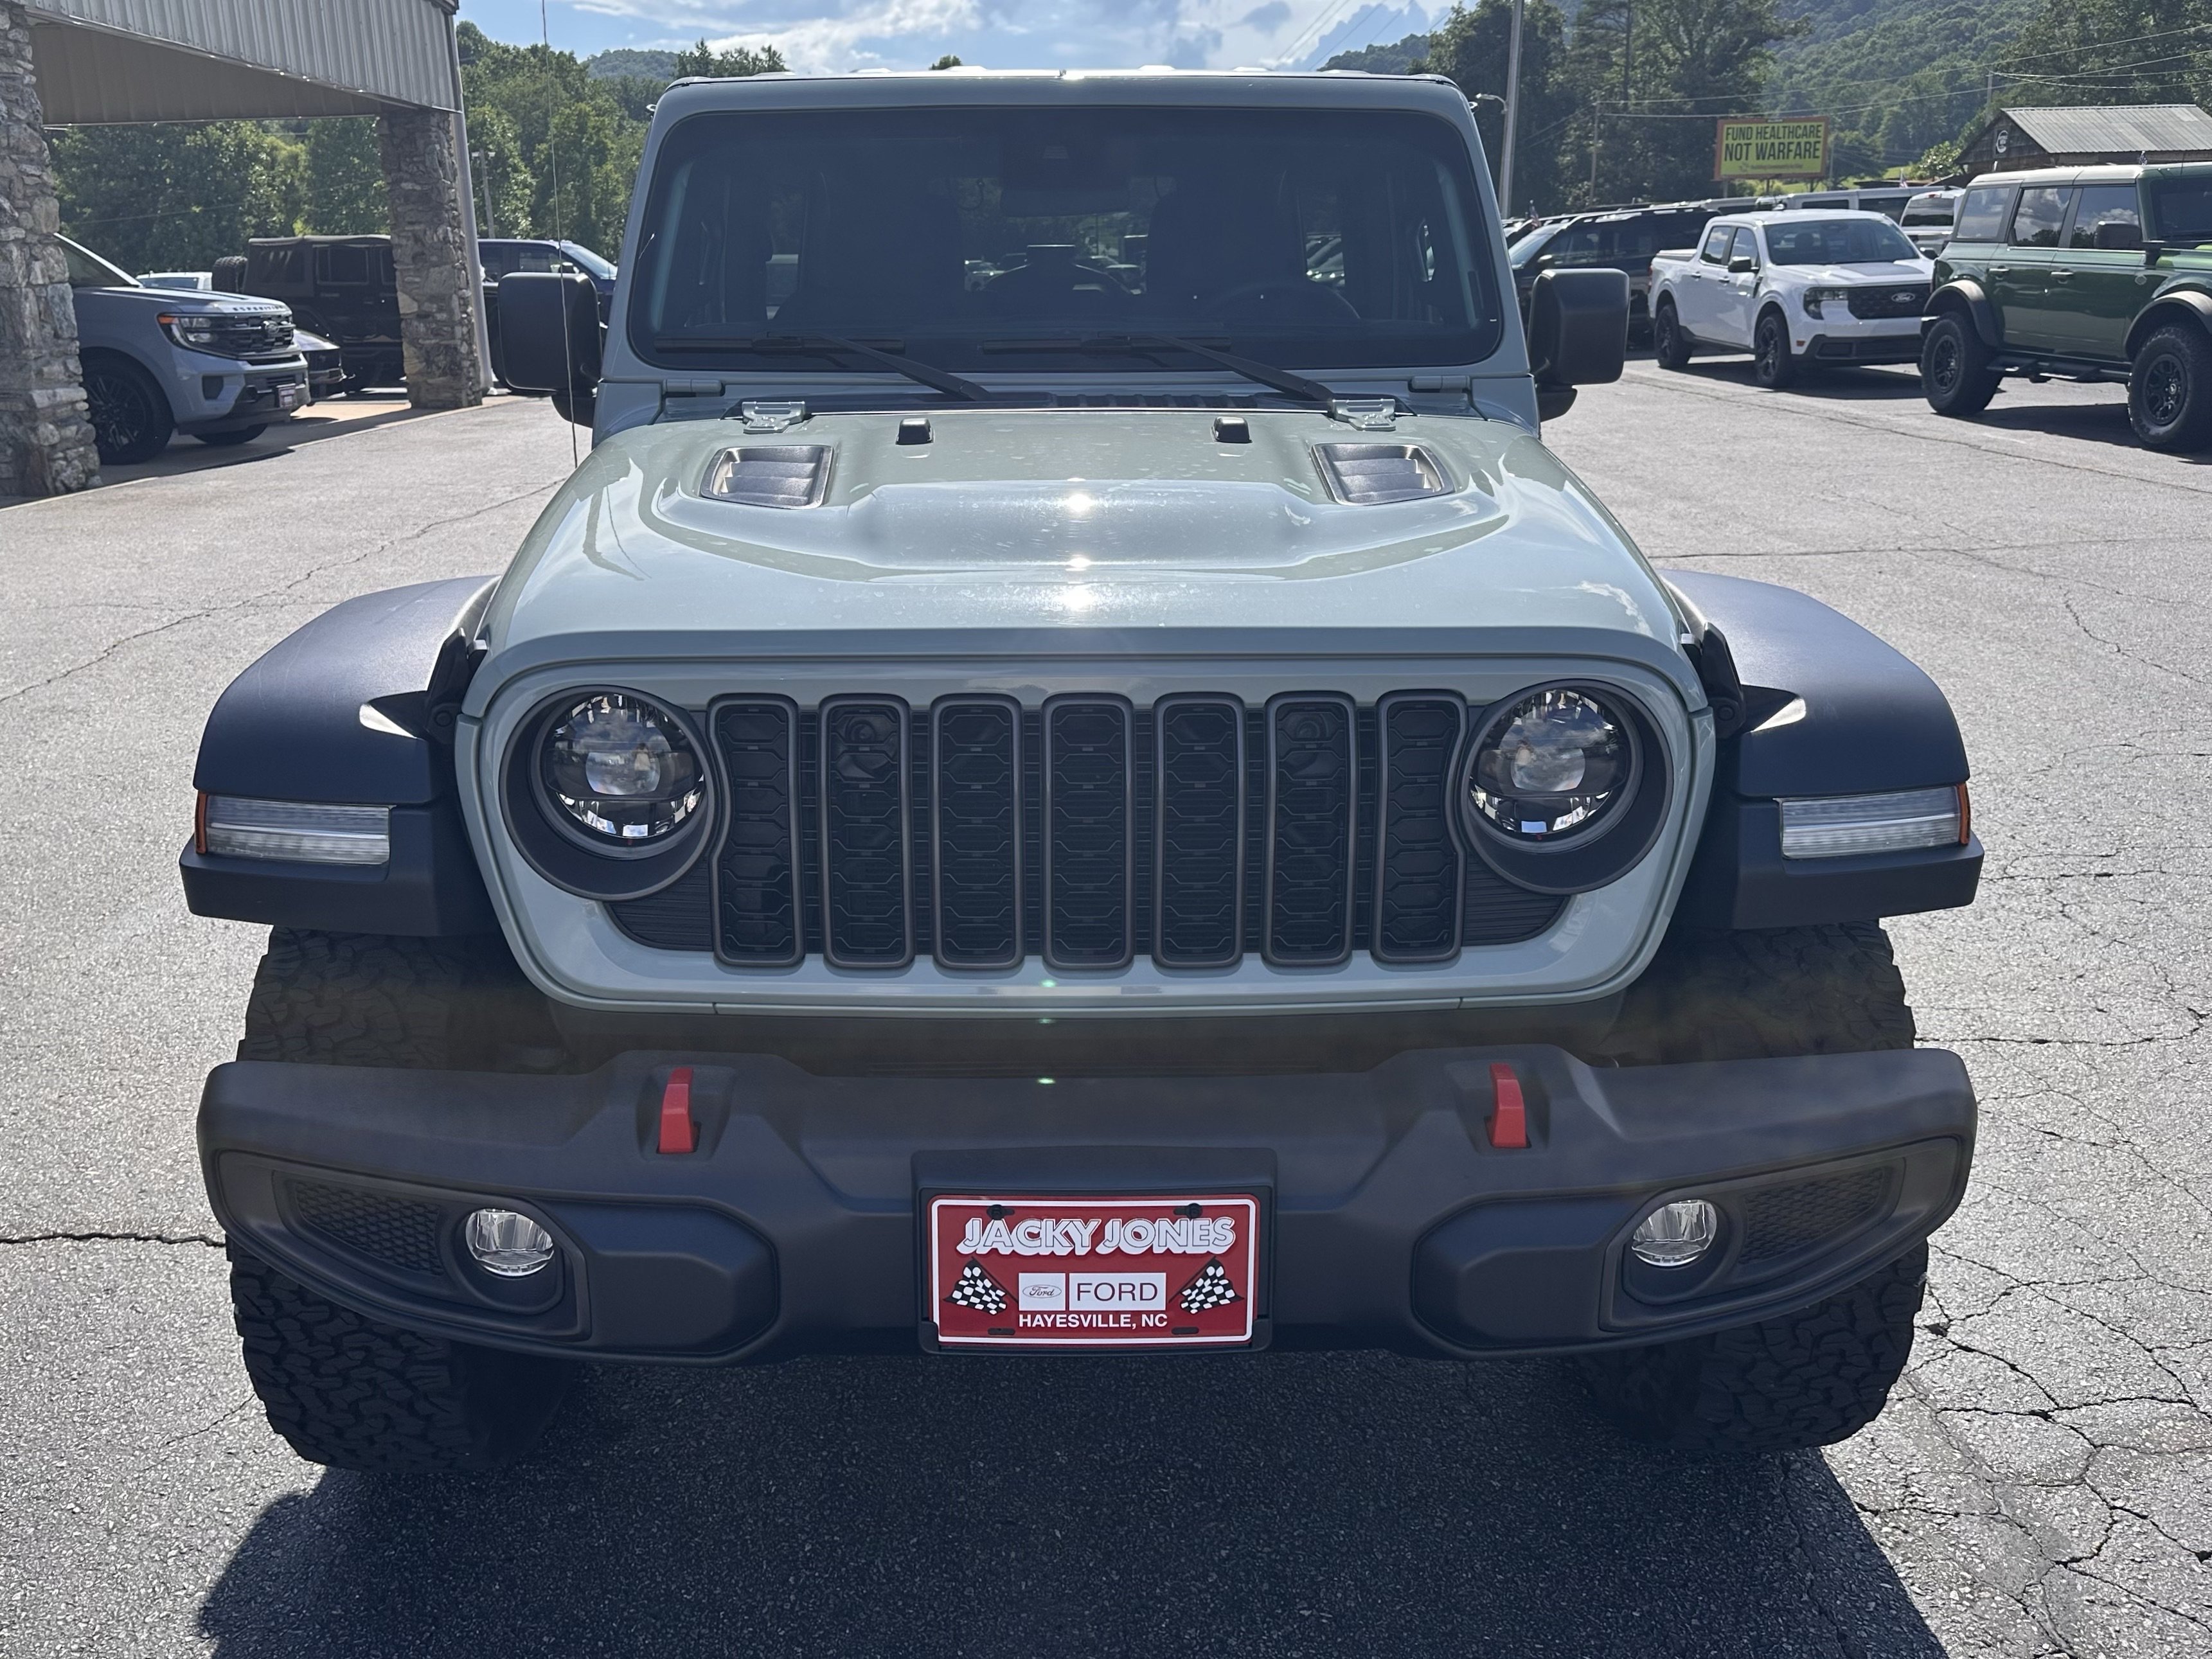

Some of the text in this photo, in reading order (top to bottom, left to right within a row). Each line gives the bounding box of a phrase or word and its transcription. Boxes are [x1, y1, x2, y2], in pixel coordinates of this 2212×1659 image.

[1726, 125, 1822, 141] FUND HEALTHCARE
[1724, 141, 1821, 161] NOT WARFARE
[956, 1216, 1236, 1255] JACKY JONES
[1026, 1282, 1159, 1302] Ford FORD
[1019, 1313, 1168, 1329] HAYESVILLE, NC
